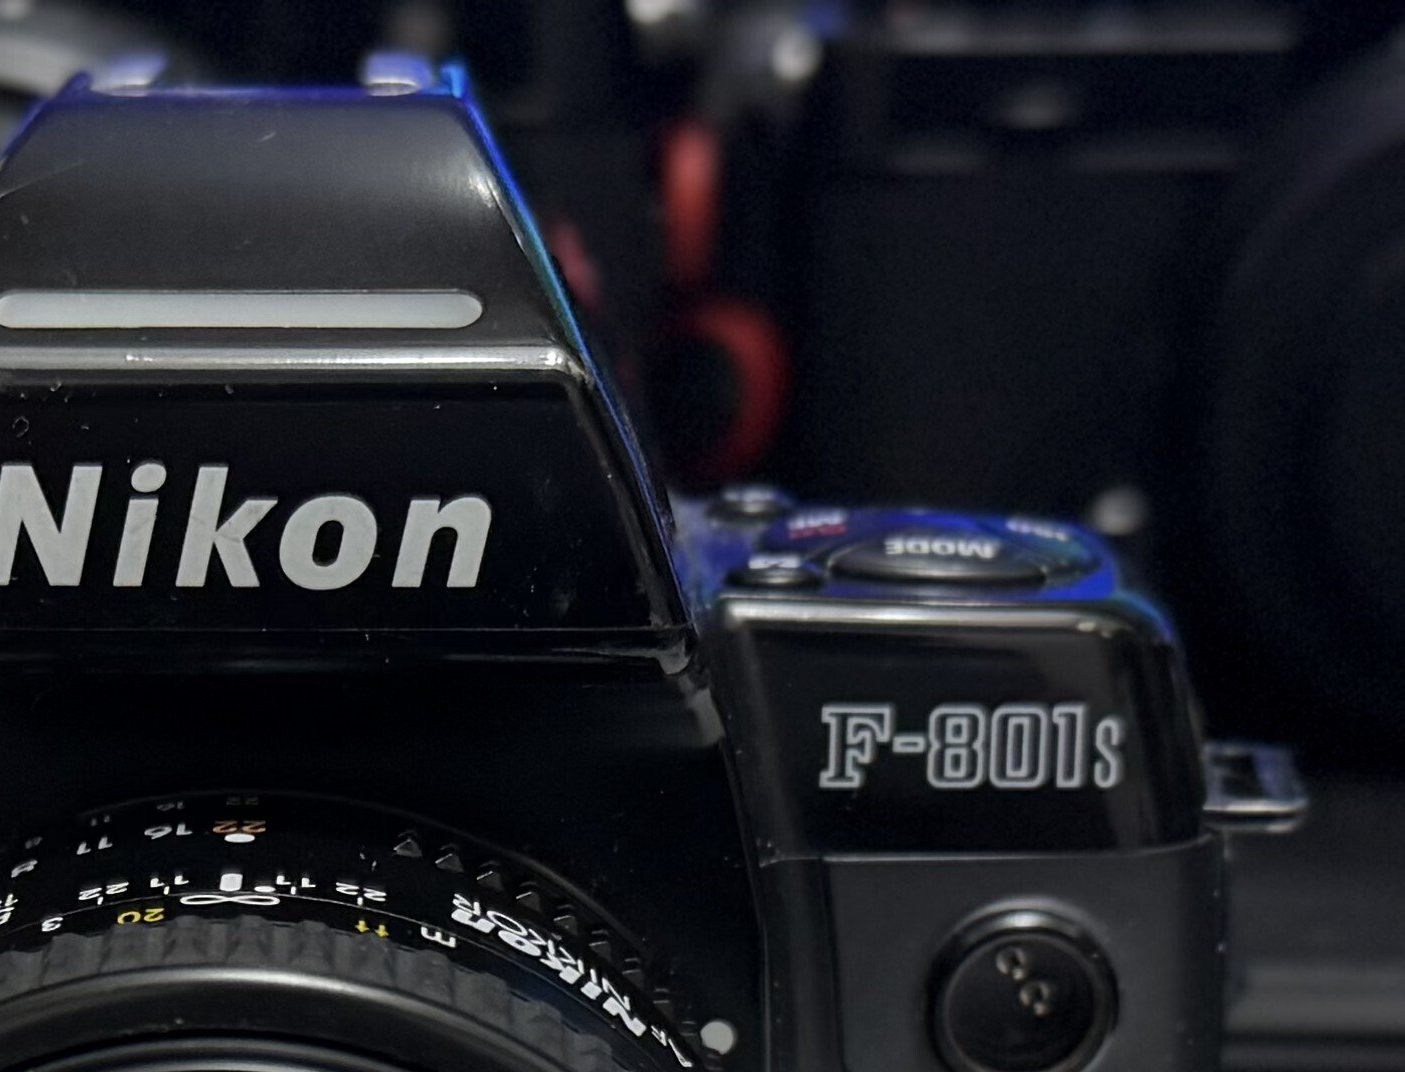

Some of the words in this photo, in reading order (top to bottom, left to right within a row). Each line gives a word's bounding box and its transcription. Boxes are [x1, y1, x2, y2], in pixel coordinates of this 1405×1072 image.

[885, 537, 996, 559] MODE
[819, 704, 1122, 789] F-801s
[144, 823, 193, 839] 16
[213, 820, 266, 833] 22
[336, 882, 387, 902] 22
[117, 908, 165, 924] 20
[41, 917, 64, 932] 3
